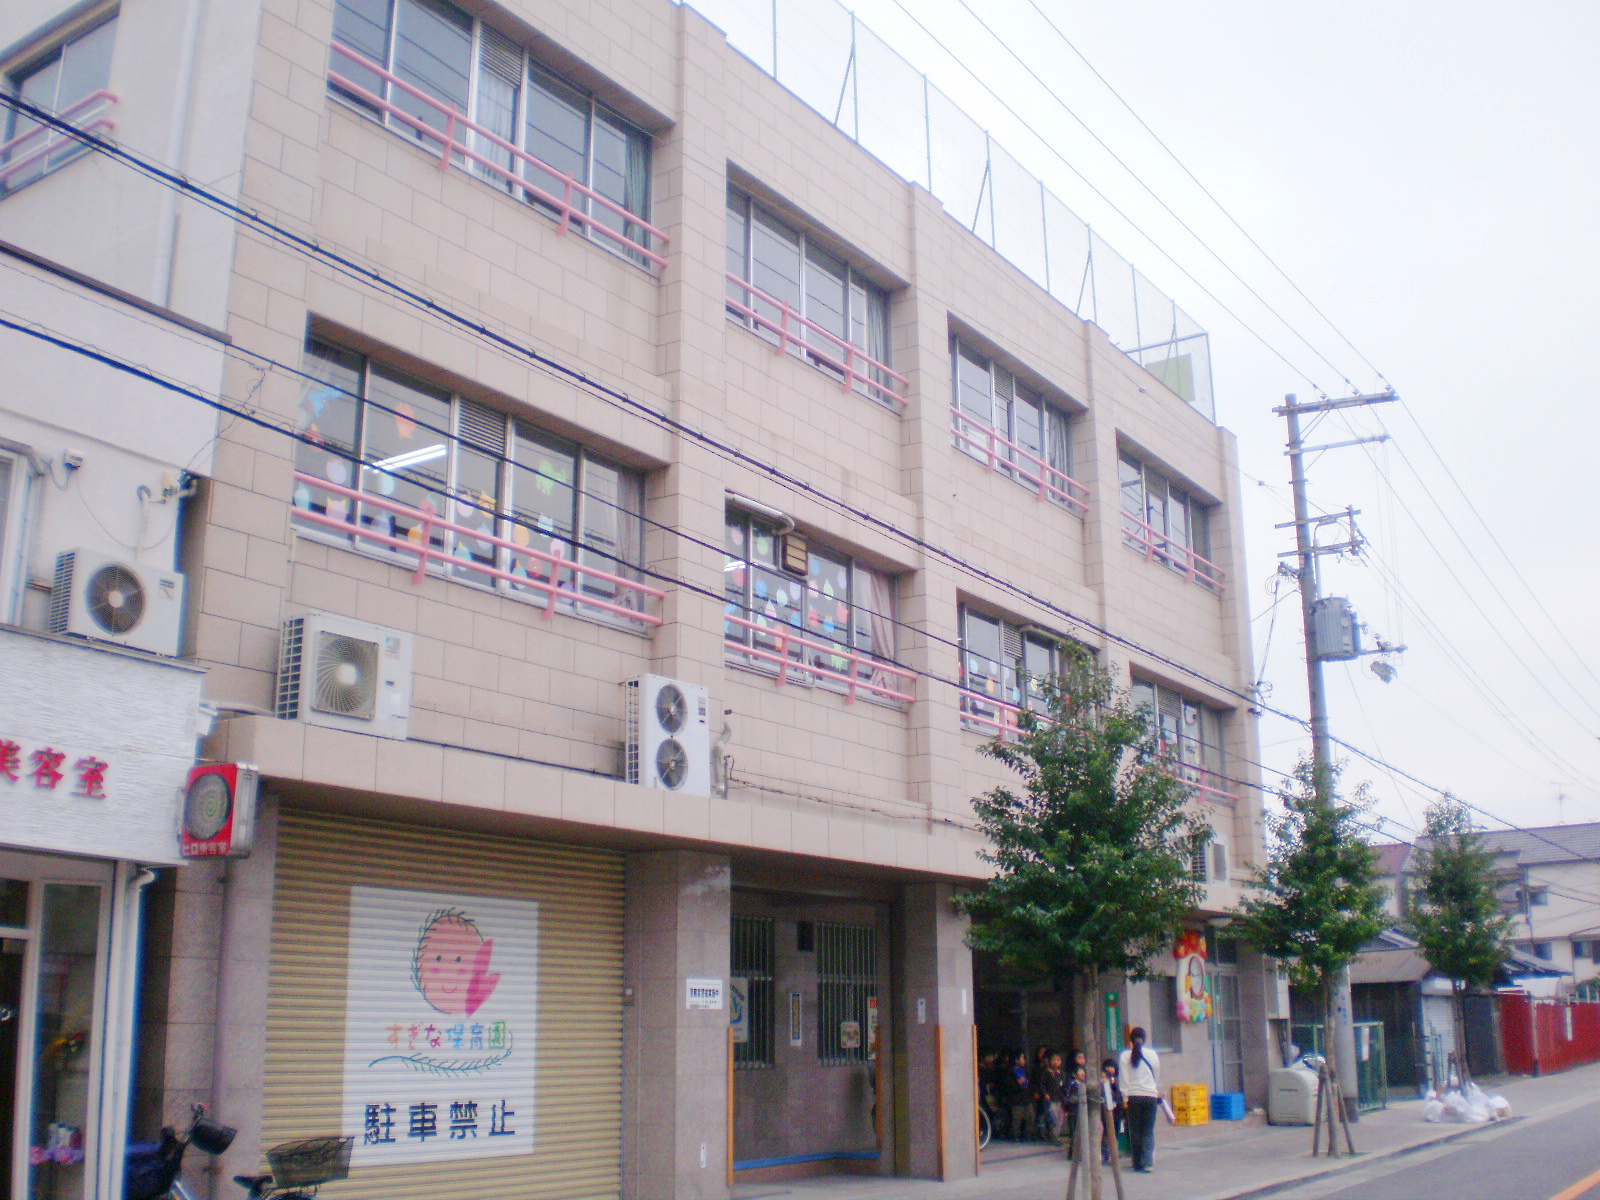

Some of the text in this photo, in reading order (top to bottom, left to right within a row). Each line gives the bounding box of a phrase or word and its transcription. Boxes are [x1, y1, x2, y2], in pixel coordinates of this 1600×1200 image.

[384, 1021, 506, 1050] すぎな保育園
[363, 1099, 516, 1146] 駐車禁止
